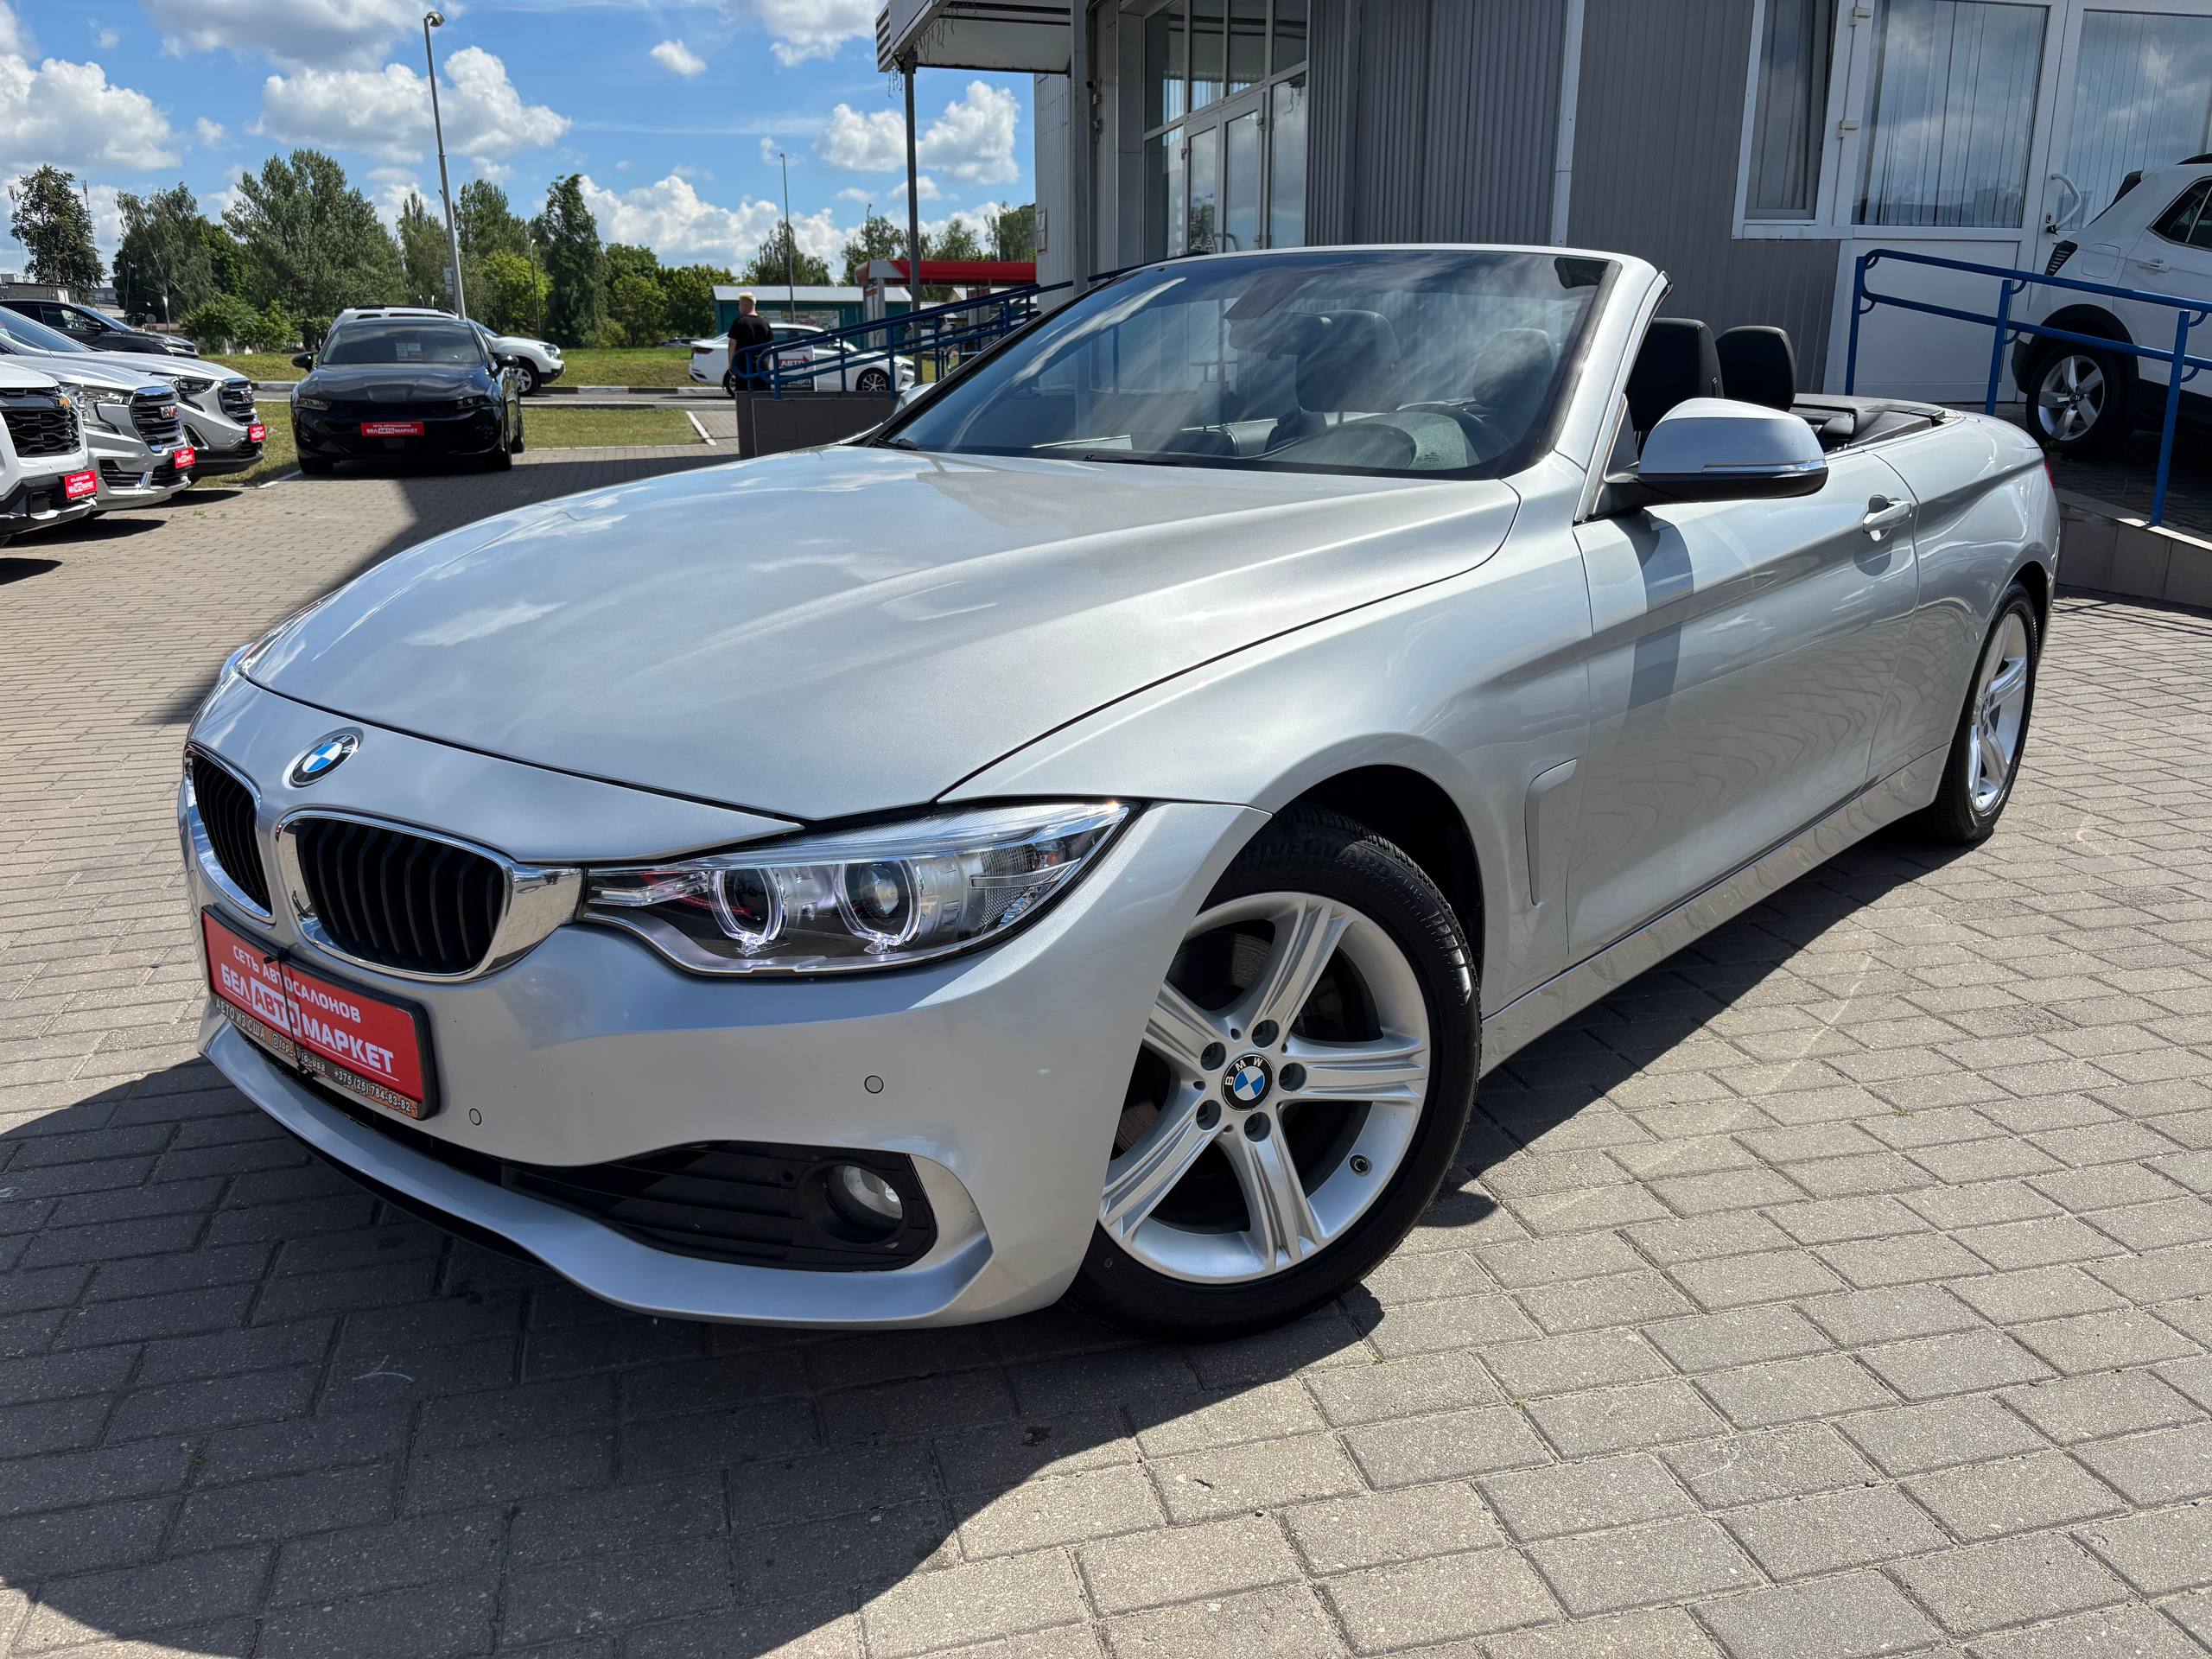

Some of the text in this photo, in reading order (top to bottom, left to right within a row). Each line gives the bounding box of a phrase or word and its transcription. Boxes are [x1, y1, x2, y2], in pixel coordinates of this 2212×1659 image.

[232, 945, 361, 1024] СЕТЬ АВТОСАЛОНОВ
[216, 997, 266, 1041] АВТО ИЗ США
[278, 1039, 411, 1112] top_uto_usa +375 (25) 784-83-82
[1224, 1056, 1263, 1086] BMW
